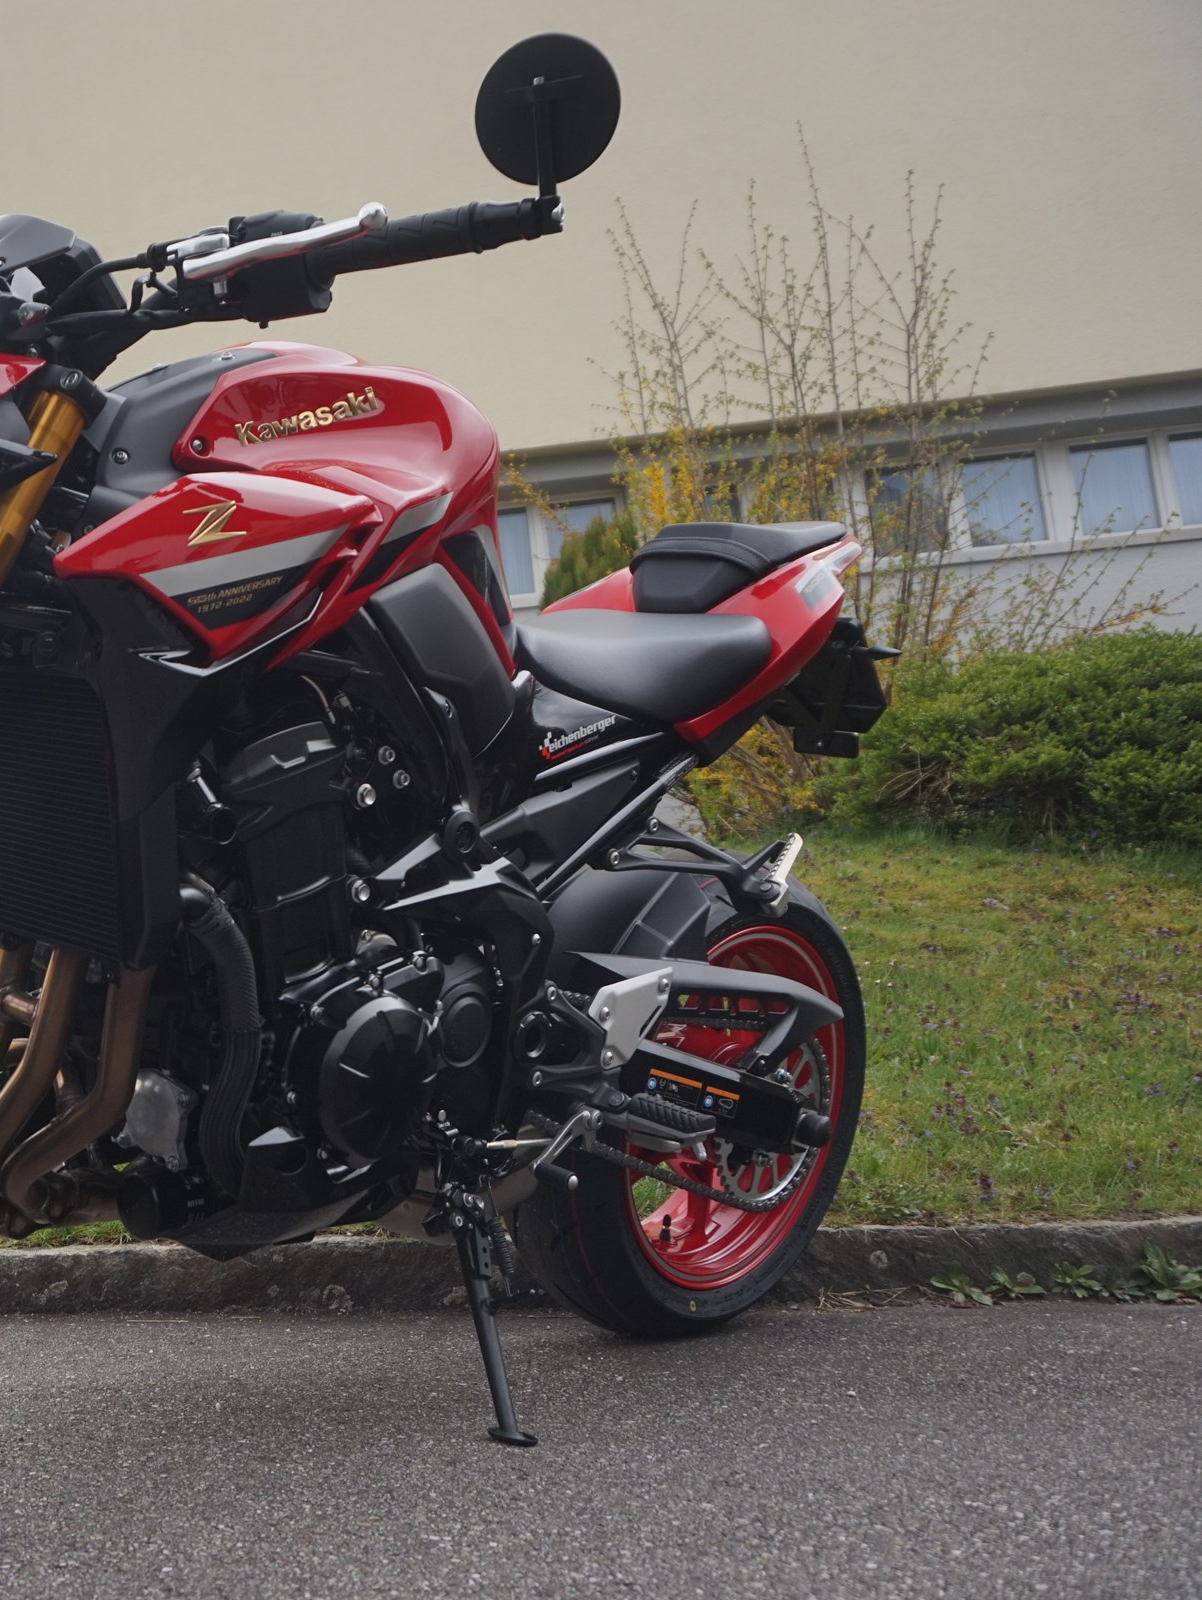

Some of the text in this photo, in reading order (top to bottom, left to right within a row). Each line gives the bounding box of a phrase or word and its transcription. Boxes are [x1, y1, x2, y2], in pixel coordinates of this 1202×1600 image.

[234, 386, 379, 447] Kawasaki
[182, 500, 247, 547] Z
[187, 575, 283, 606] 50th ANNIVERSARY
[197, 594, 253, 614] 1972-2022
